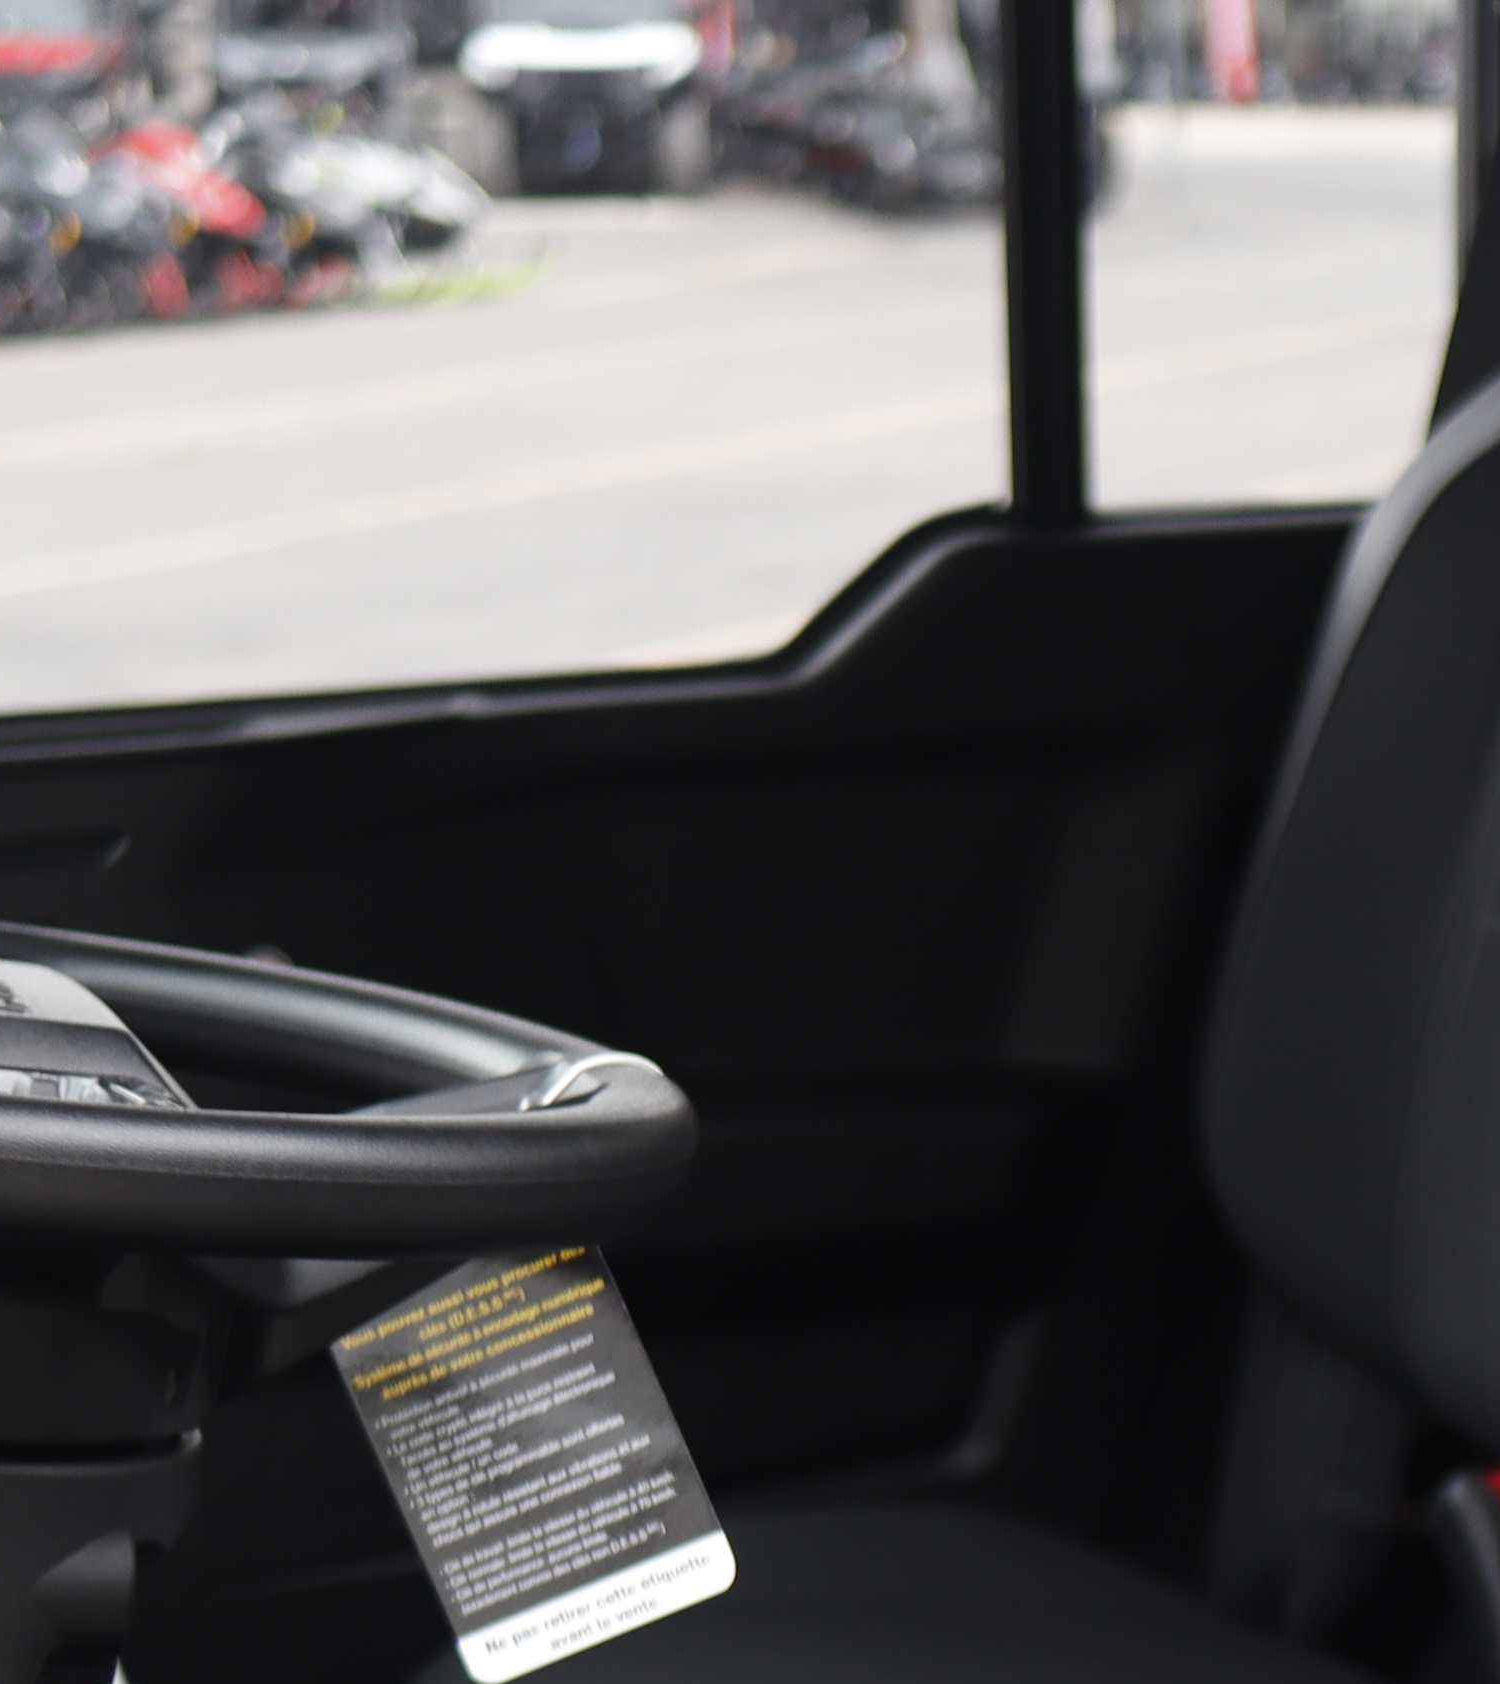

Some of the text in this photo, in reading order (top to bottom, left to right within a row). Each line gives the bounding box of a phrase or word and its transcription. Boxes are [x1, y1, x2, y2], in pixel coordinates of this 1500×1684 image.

[484, 1554, 711, 1653] Ne pas retirer cette étiquette
[550, 1623, 594, 1650] avant
